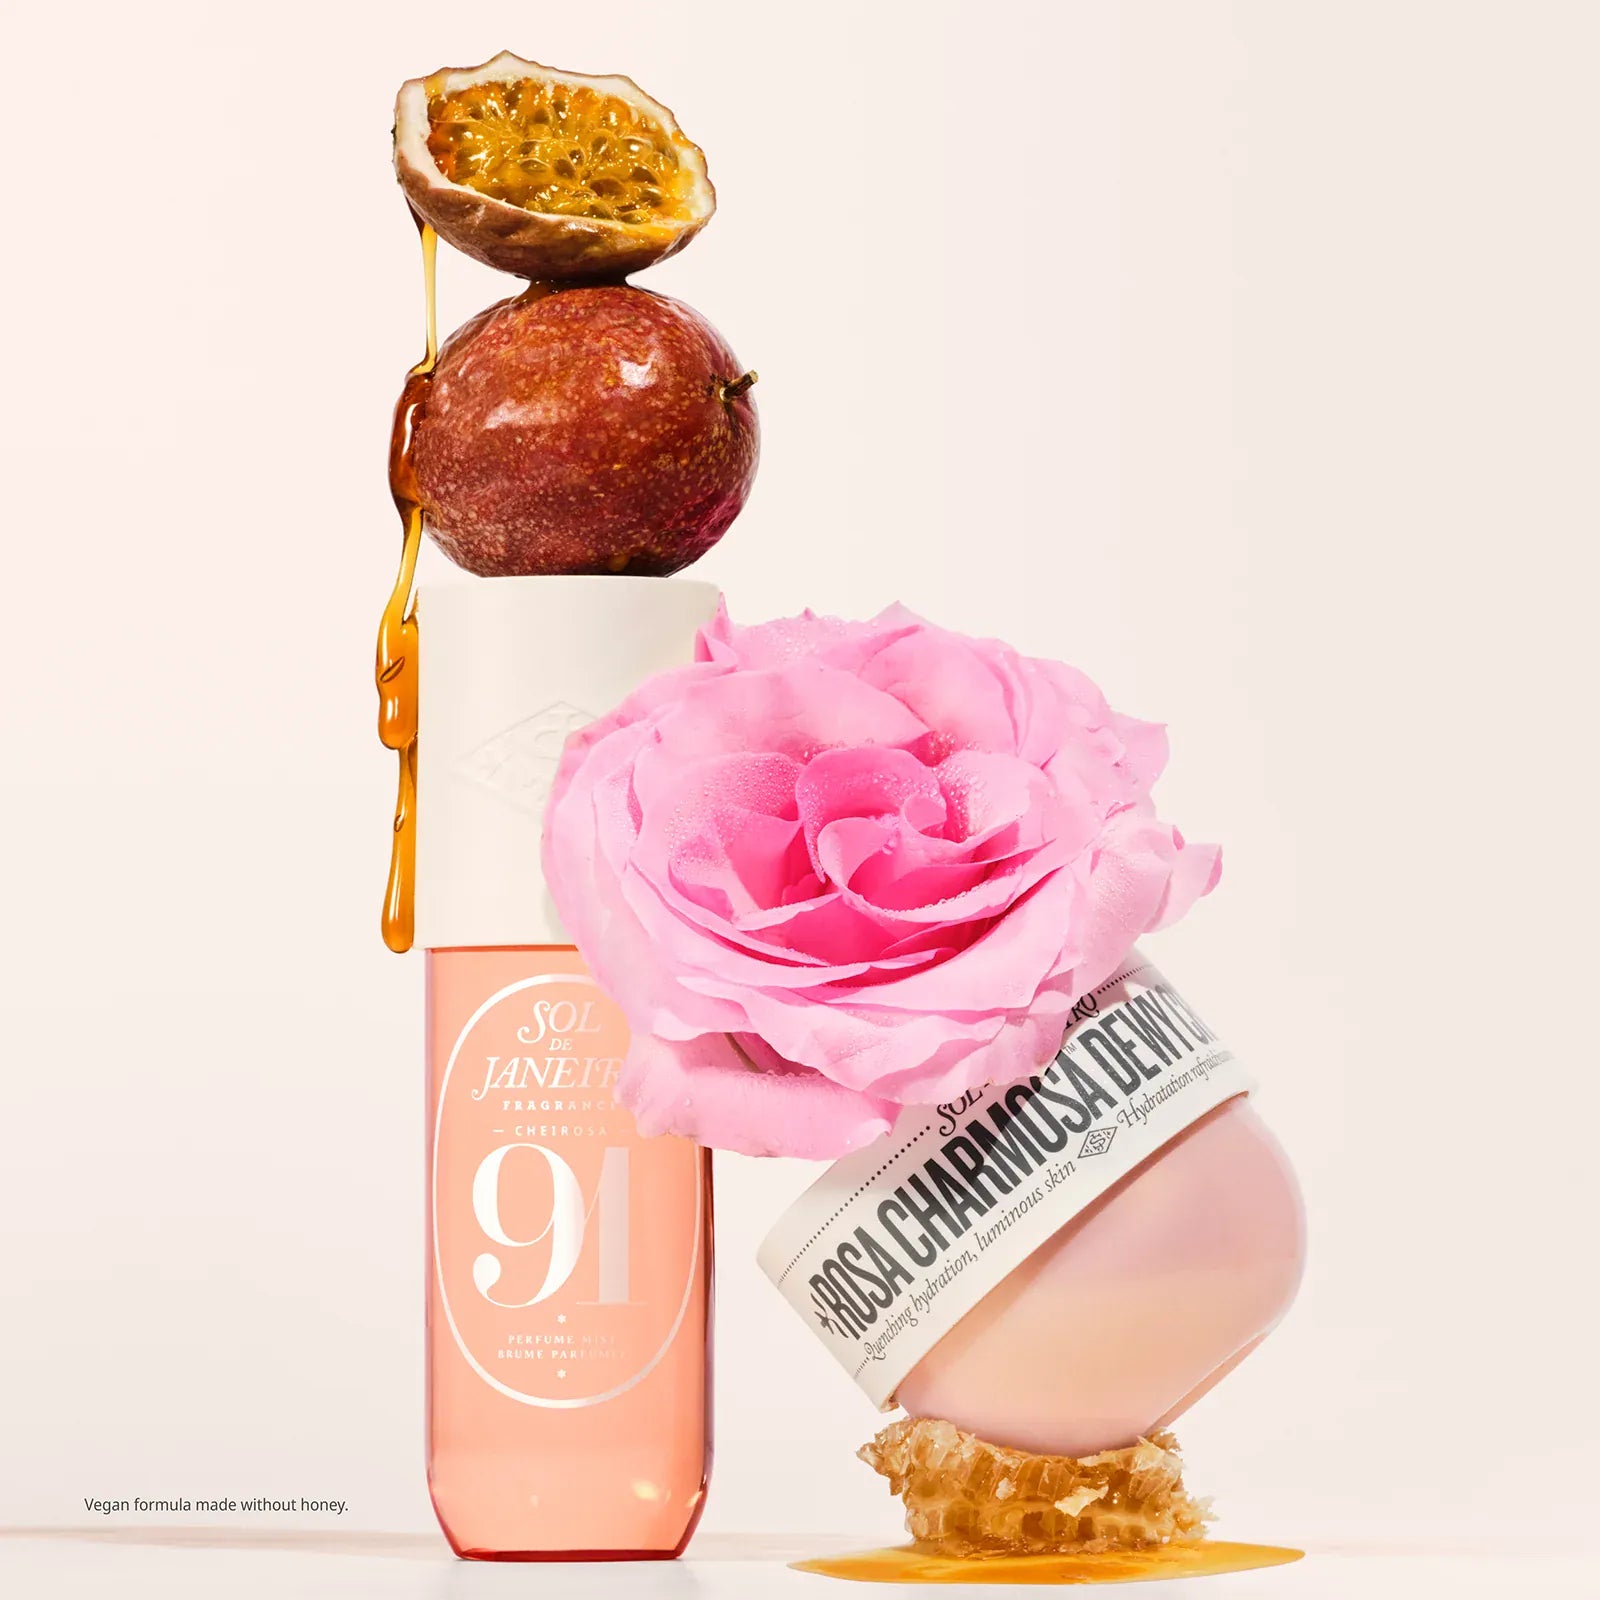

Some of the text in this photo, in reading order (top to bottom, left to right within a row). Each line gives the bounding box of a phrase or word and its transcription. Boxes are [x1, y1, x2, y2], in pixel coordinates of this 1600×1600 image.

[517, 1000, 601, 1044] SOL
[549, 1038, 573, 1051] DE
[471, 1057, 624, 1101] JANEIR
[1116, 1068, 1194, 1129] Hydratation
[514, 1125, 608, 1137] CHEIROSA
[808, 1225, 915, 1341] ROSA
[1077, 989, 1195, 1097] DEWY
[472, 1143, 648, 1308] 91
[863, 1160, 1077, 1361] Quenching hydration, luminous skin
[497, 1349, 544, 1359] BRUME
[508, 1334, 575, 1345] PERFUME
